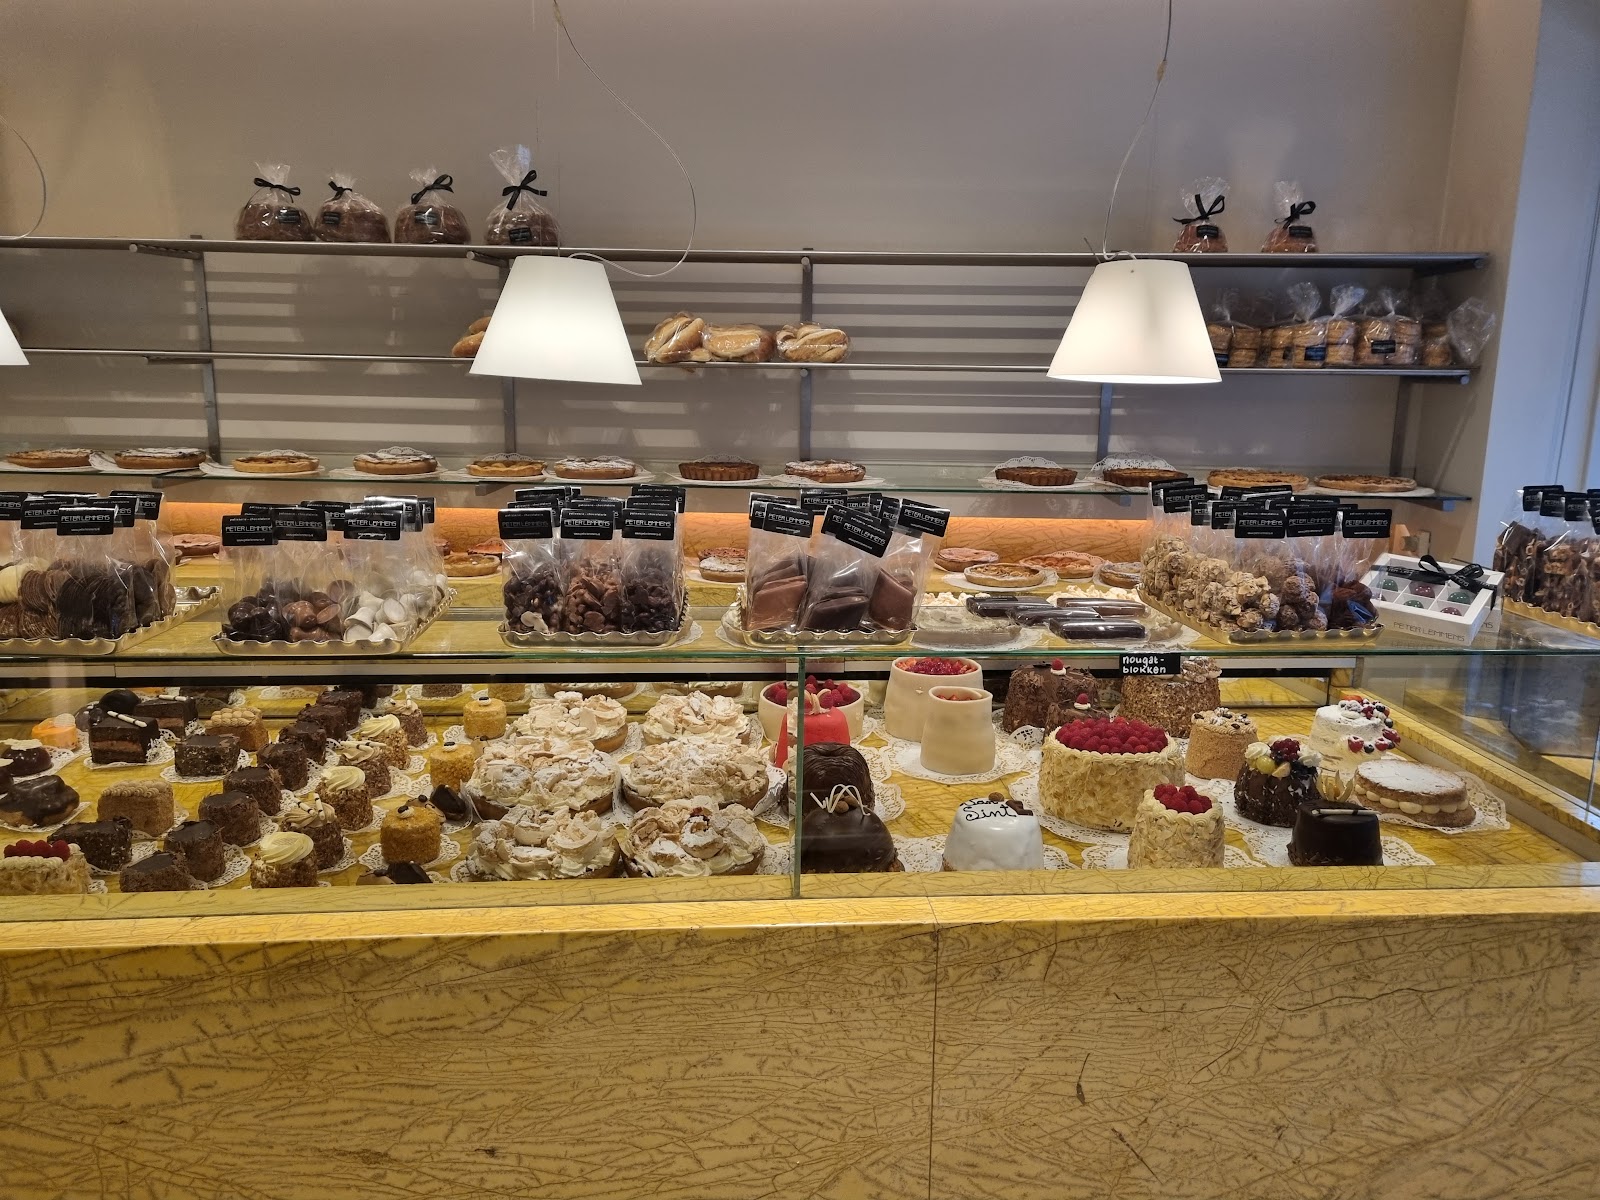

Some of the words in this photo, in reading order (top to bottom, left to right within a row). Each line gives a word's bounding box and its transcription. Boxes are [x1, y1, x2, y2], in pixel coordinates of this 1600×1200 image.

[767, 513, 786, 521] PETER
[625, 518, 644, 526] PETER
[843, 522, 862, 533] PETER
[1393, 621, 1421, 633] PETER
[1422, 627, 1465, 642] LEMMENS
[1122, 666, 1166, 674] blokken
[963, 804, 1017, 821] Sint
